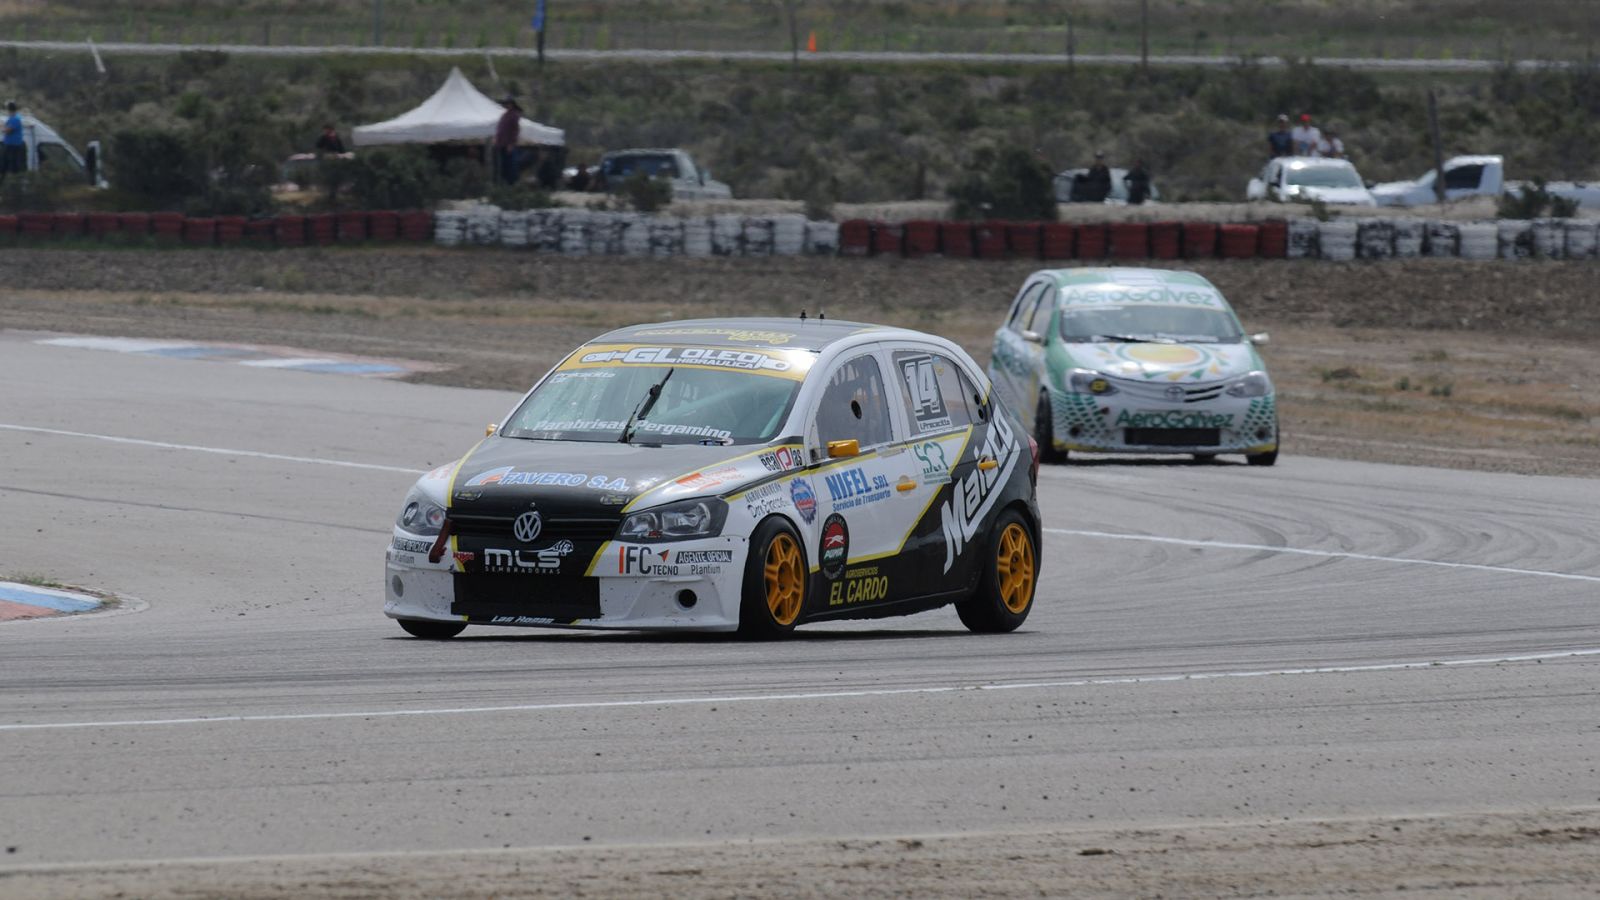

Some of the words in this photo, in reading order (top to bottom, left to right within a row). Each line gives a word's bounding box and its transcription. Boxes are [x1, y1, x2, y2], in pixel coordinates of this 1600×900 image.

[1066, 286, 1215, 306] AeroGalvez
[623, 348, 678, 363] GL
[680, 349, 762, 363] OLEO
[904, 360, 941, 416] 14
[1115, 408, 1235, 428] AeroGalvez
[533, 419, 626, 432] Parabrisas
[636, 420, 731, 439] Pergamino
[587, 475, 631, 491] S.A.
[825, 467, 872, 500] NIFEL
[872, 474, 889, 490] SRL
[619, 546, 652, 574] IFC
[678, 551, 705, 564] AGENTE
[706, 551, 731, 563] OFICIAL
[484, 566, 561, 575] SEMBRADORAS
[653, 564, 679, 576] TECNO
[691, 564, 721, 575] Plantium
[829, 581, 845, 606] EL
[847, 575, 888, 603] CARDO
